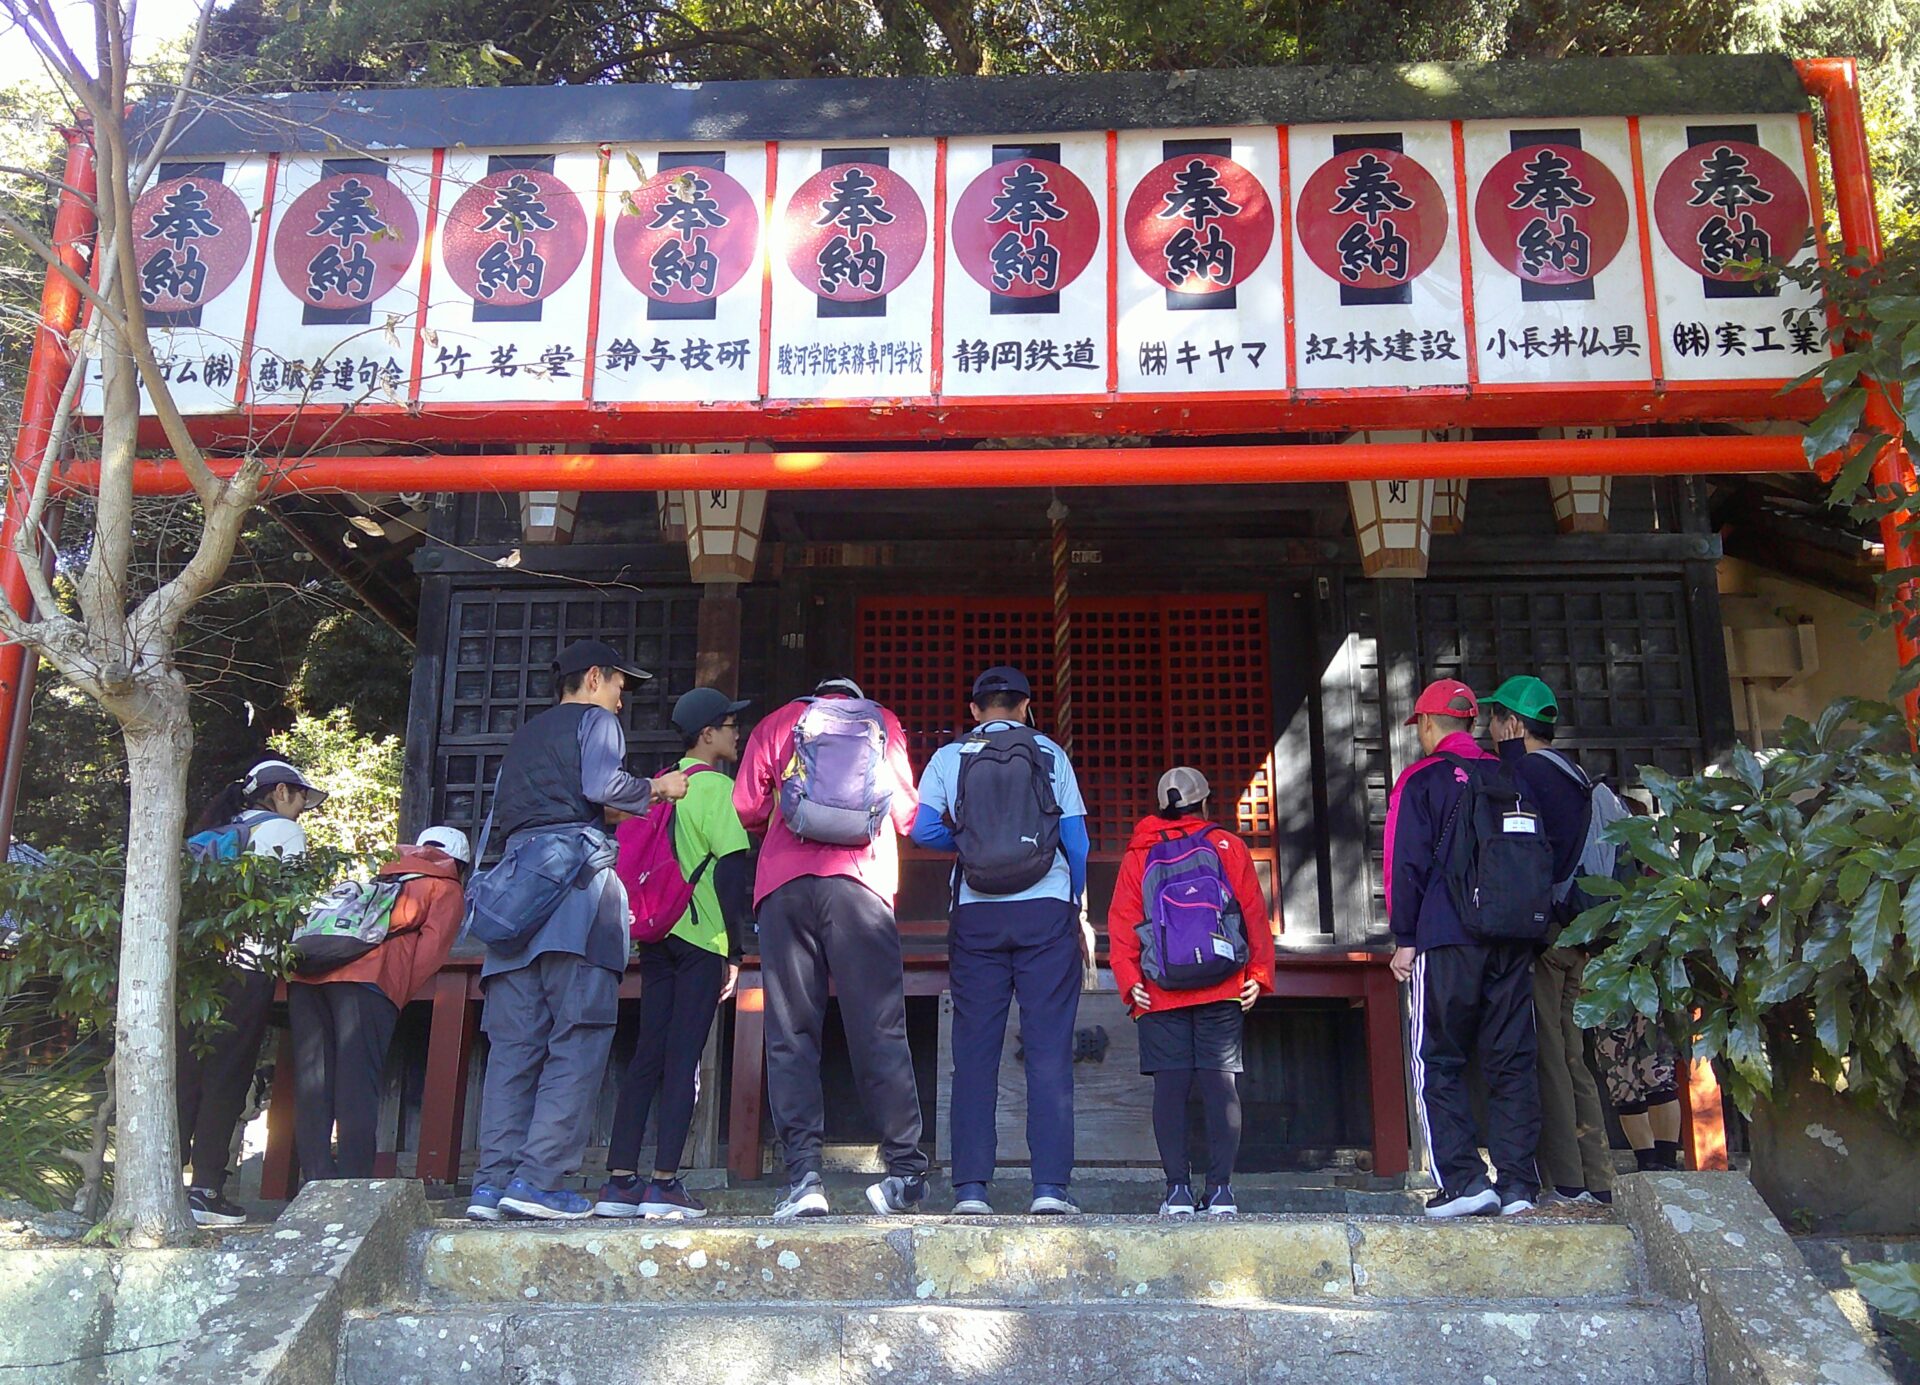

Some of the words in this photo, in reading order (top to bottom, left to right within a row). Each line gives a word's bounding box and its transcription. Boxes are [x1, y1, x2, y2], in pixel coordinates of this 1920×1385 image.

[141, 182, 223, 304] 奉納
[306, 179, 387, 300] 奉納
[475, 174, 558, 300] 奉納
[648, 172, 729, 296] 奉納
[813, 167, 896, 295] 奉納
[983, 163, 1069, 291] 奉納
[1162, 159, 1241, 287] 奉納
[1329, 153, 1416, 282] 奉納
[1508, 149, 1597, 277] 奉納
[1687, 146, 1774, 274] 奉納
[435, 343, 575, 379] 竹茗堂
[605, 337, 751, 372] 鈴与技研
[952, 337, 1100, 374] 静岡鉄道
[1305, 329, 1462, 364] 紅林建設
[1486, 324, 1642, 359] 小長井仏具
